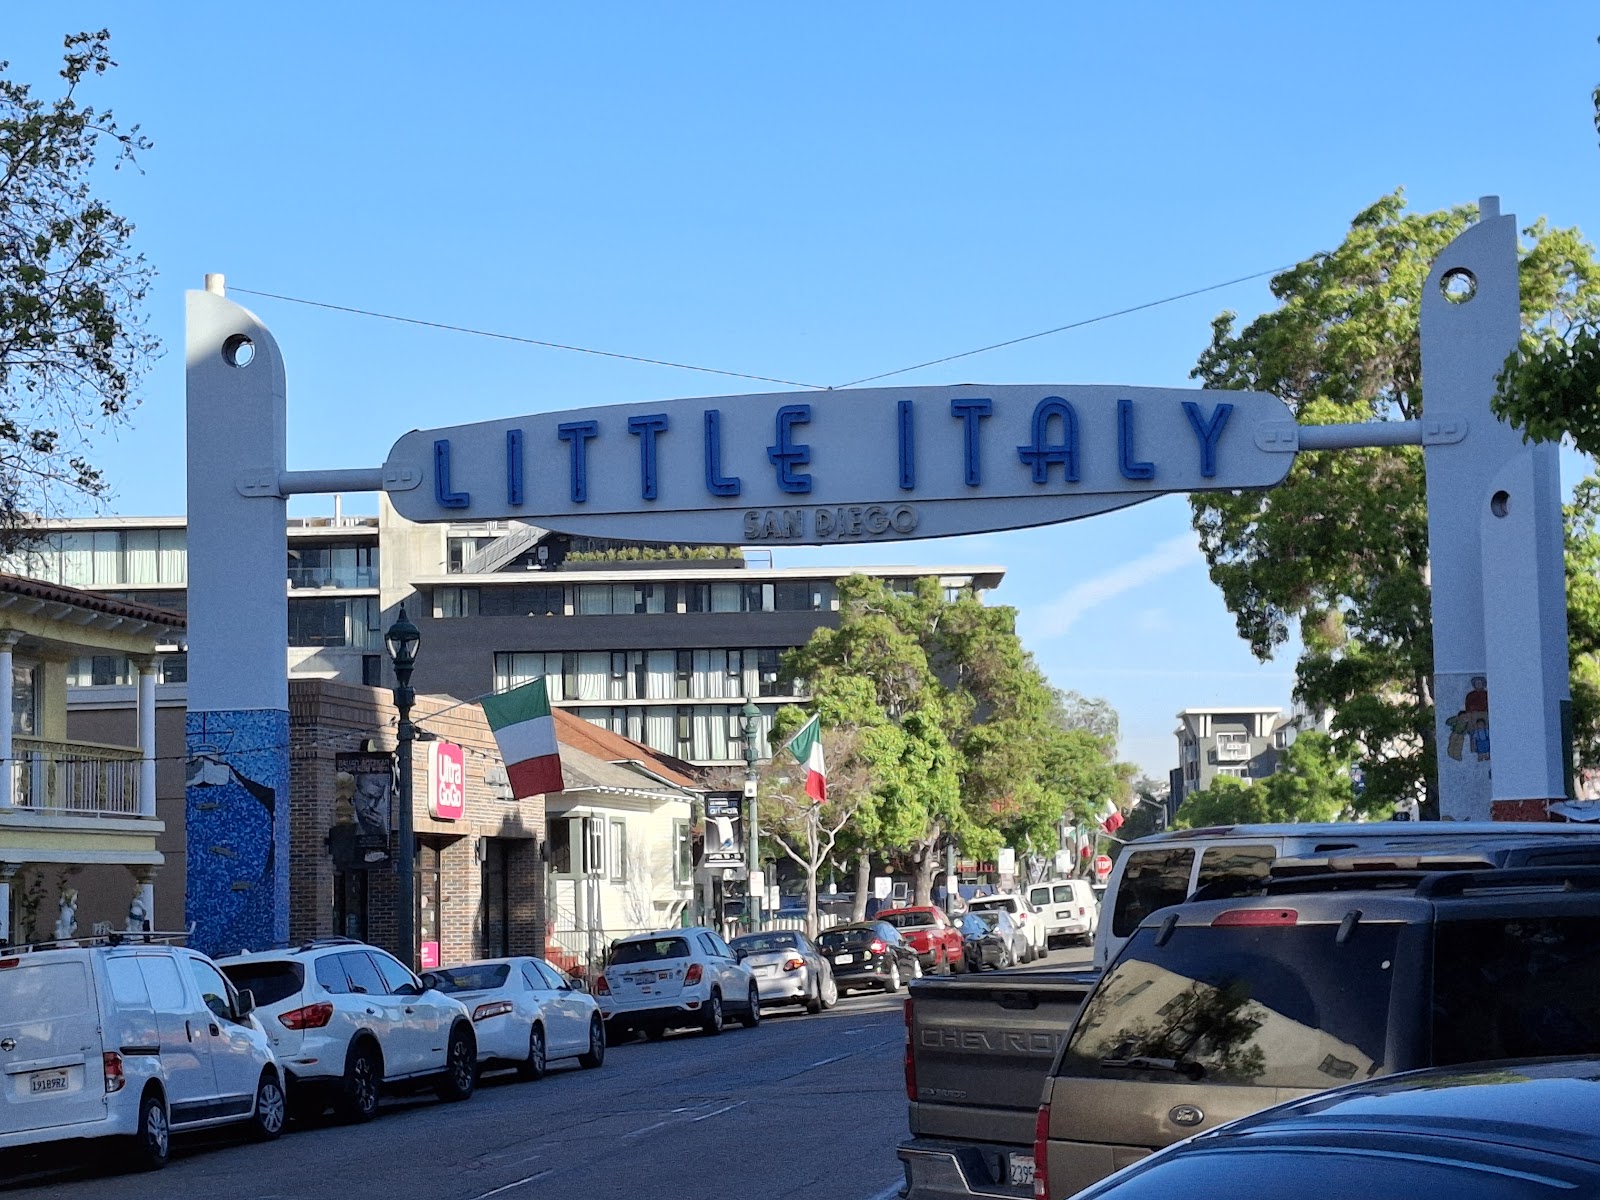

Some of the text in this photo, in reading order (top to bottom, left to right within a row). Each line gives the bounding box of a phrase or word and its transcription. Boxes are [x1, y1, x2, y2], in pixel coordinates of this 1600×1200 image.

[434, 396, 1234, 508] LITTLE ITALY
[743, 504, 919, 540] SAN DIEGO
[438, 753, 462, 785] Ultra
[438, 782, 462, 808] GoGo
[1096, 860, 1111, 870] STOP
[1176, 1108, 1195, 1122] Ford
